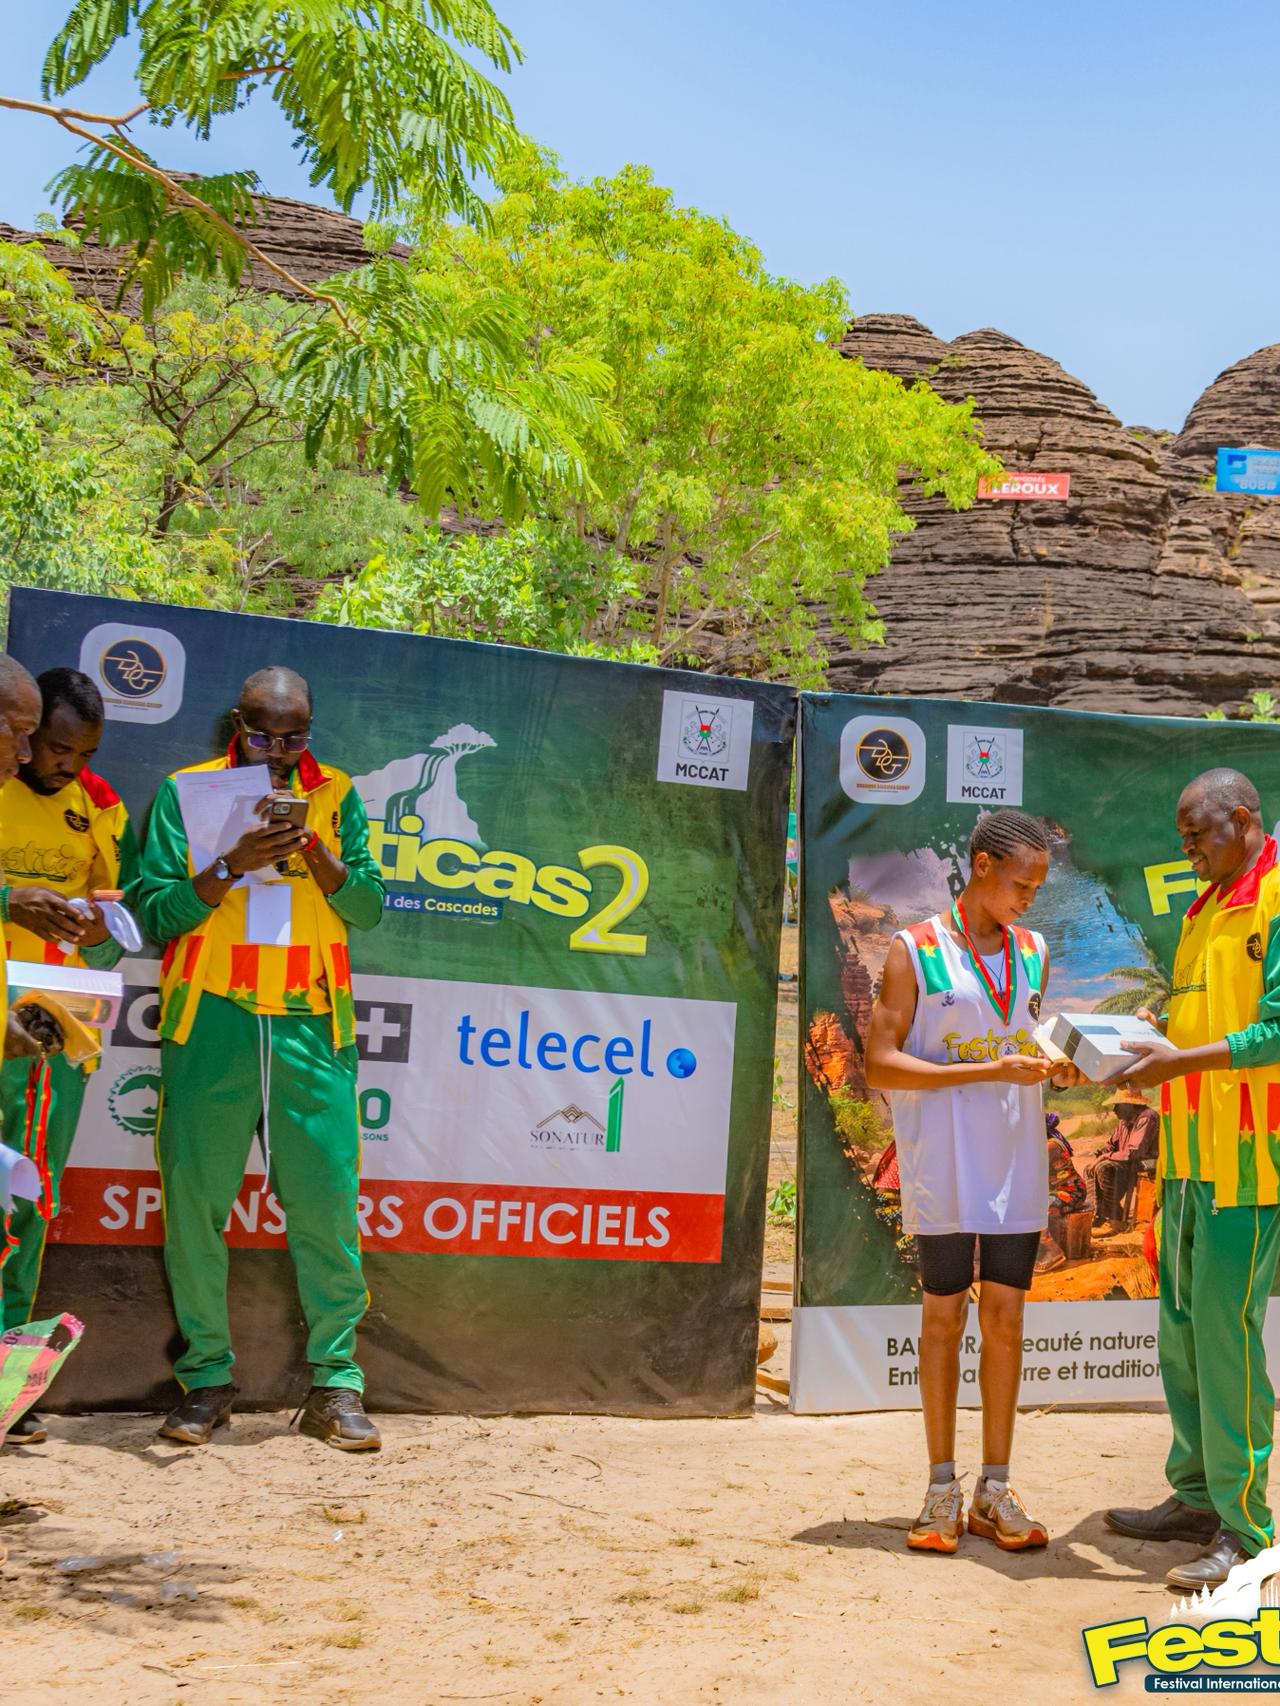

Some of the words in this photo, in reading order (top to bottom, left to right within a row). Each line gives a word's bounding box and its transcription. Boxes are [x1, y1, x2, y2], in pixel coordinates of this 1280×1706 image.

[675, 762, 729, 782] MCCAT
[961, 785, 1007, 800] MCCAT
[367, 815, 593, 918] ticas
[394, 896, 421, 910] des
[424, 897, 498, 917] Cascades
[457, 1010, 655, 1078] telecel
[99, 1184, 404, 1238] SPNSRS
[423, 1197, 671, 1248] OFFICIELS
[1022, 1331, 1083, 1353] eauté
[888, 1367, 919, 1386] Ent
[1057, 1361, 1078, 1380] et
